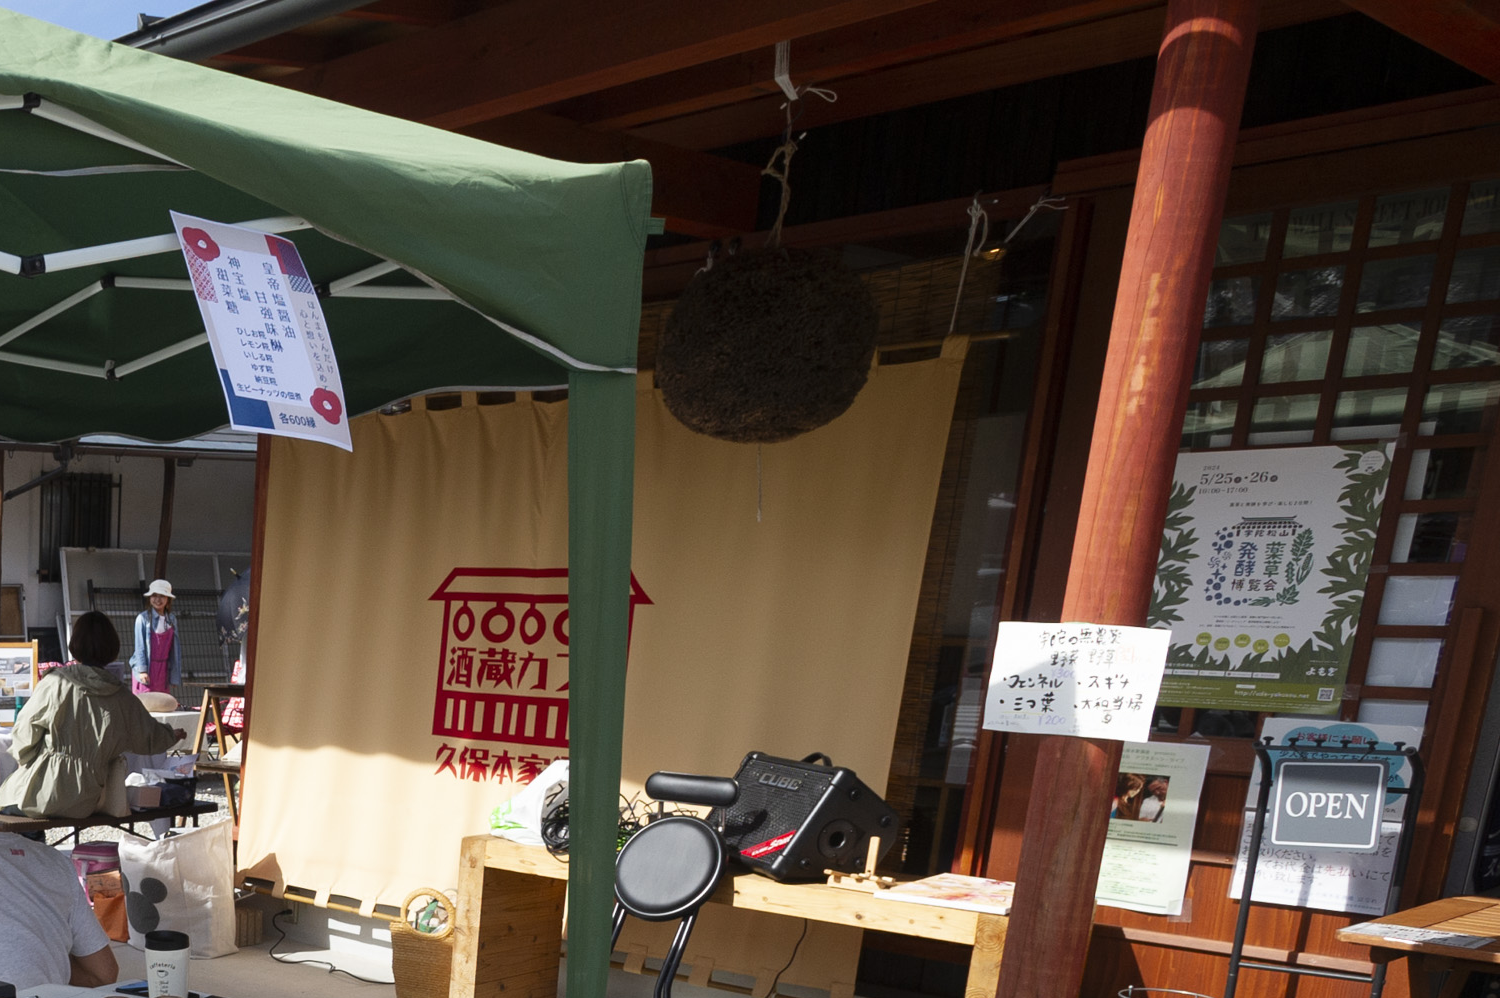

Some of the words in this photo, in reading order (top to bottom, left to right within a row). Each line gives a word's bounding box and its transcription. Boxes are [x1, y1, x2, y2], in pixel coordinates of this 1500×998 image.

[1234, 541, 1258, 577] 発酵
[1263, 541, 1286, 578] 薬草
[1230, 578, 1278, 592] 博覧会
[434, 743, 569, 786] 久保本家
[1285, 791, 1370, 819] OPEN
